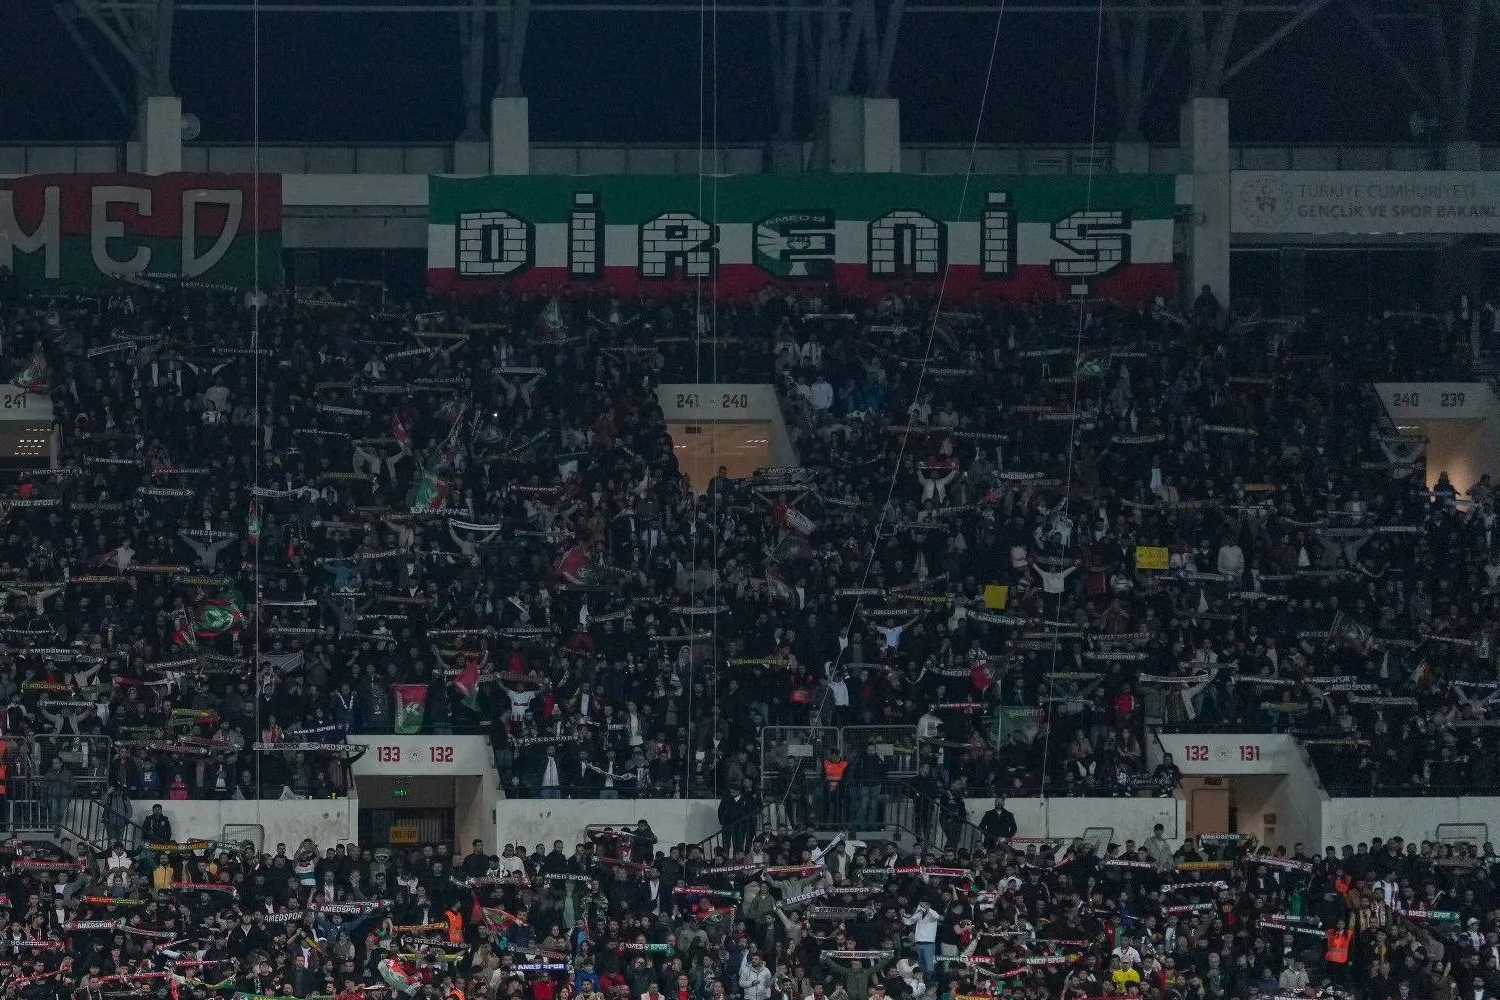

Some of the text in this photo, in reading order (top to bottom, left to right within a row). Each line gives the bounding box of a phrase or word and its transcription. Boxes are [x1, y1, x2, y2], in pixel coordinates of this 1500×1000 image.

[4, 394, 27, 408] 241
[677, 394, 748, 408] 241 240
[1393, 392, 1466, 406] 240 239
[377, 747, 454, 763] 133 132
[1186, 746, 1260, 761] 132 131
[786, 889, 825, 905] AMEDSPOR
[265, 913, 303, 924] AMEDSPOR
